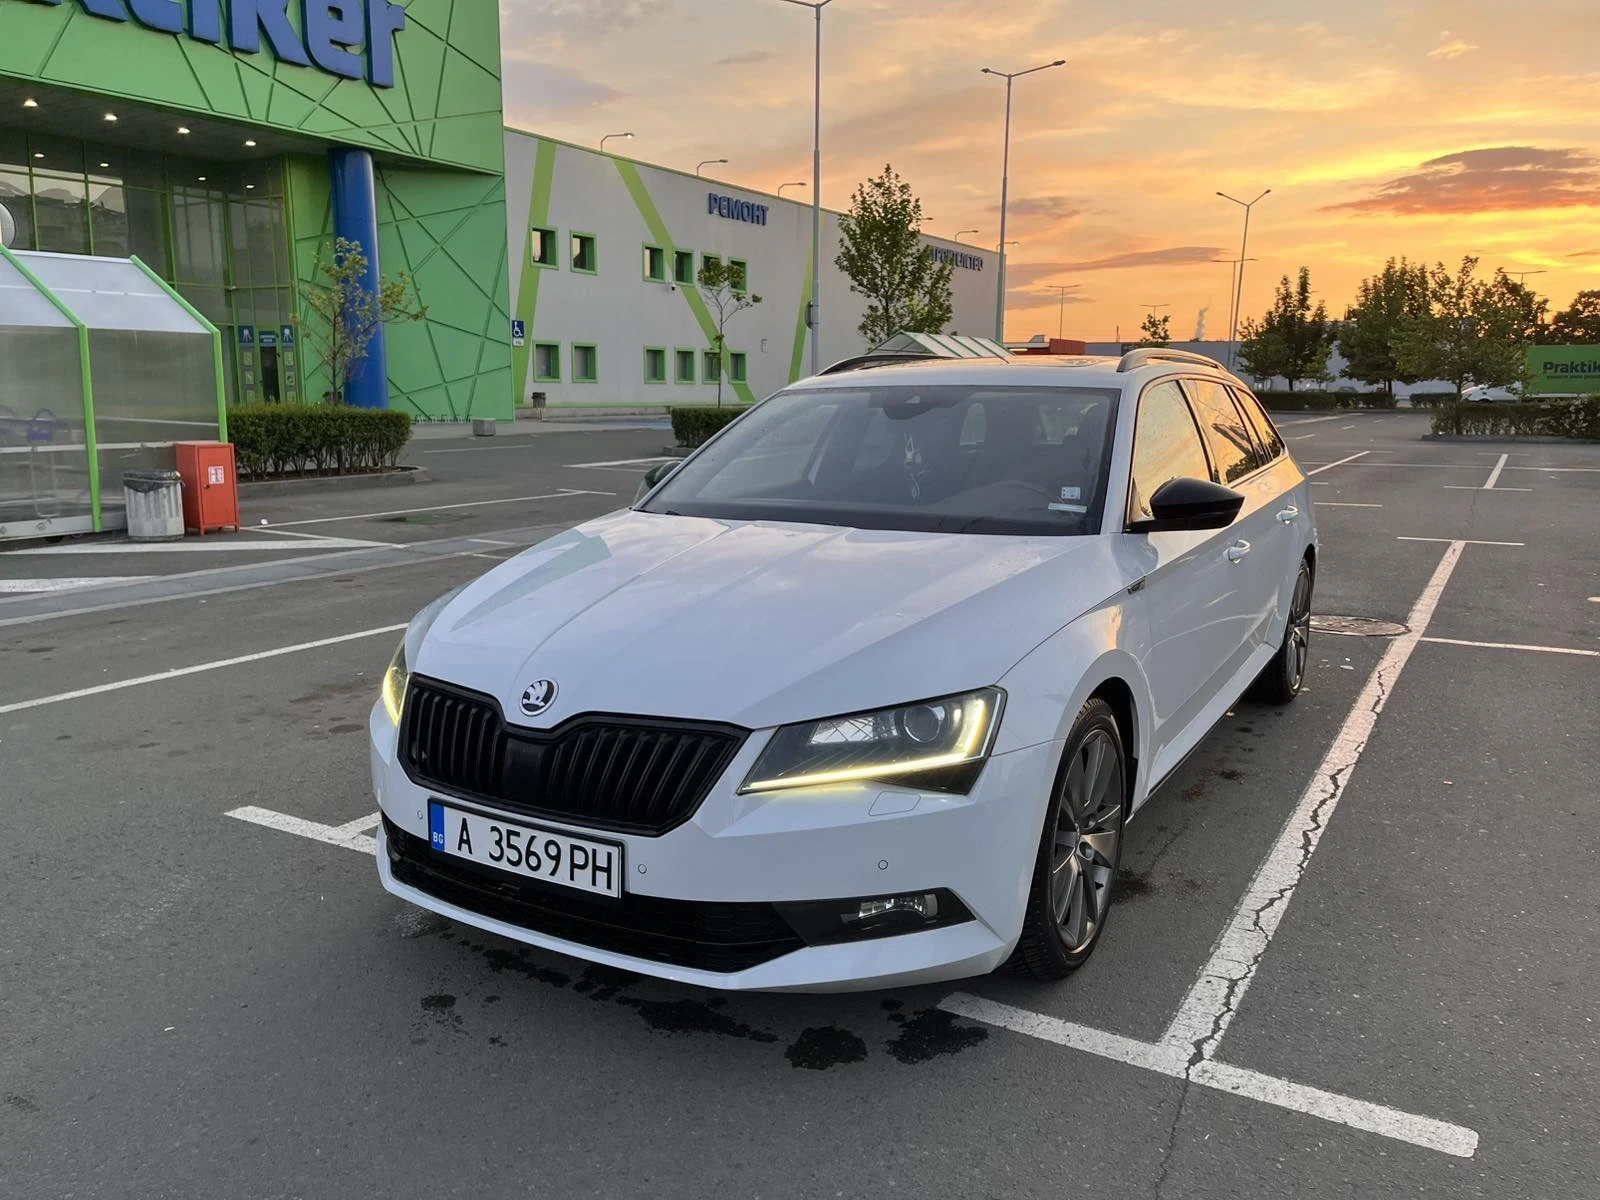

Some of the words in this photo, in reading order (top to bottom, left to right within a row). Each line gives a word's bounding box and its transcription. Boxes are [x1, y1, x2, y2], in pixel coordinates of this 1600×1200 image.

[708, 192, 769, 226] РЕМОНТ
[432, 831, 444, 845] BG
[457, 817, 473, 855] A
[488, 825, 562, 877] 3569
[569, 843, 613, 890] PH
